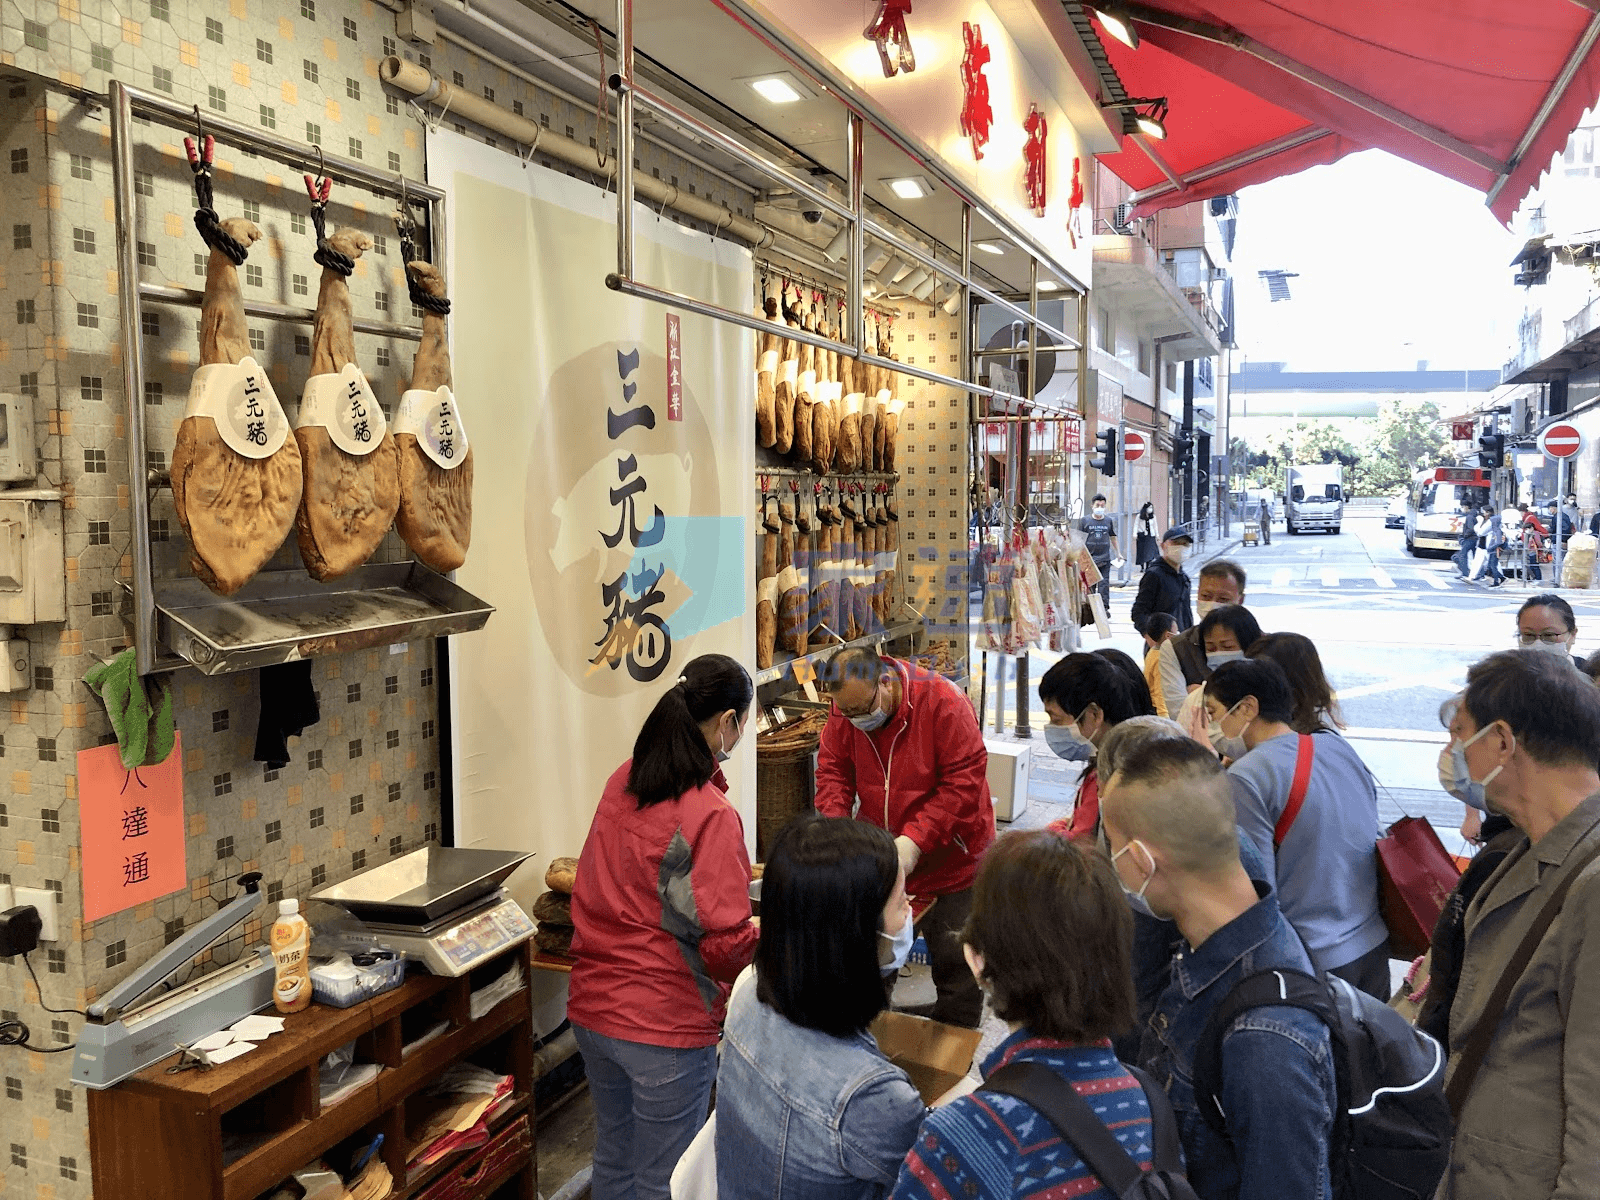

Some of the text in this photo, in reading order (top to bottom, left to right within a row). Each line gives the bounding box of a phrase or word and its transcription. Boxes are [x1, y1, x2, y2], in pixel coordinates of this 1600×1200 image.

[244, 376, 268, 446] 三元豬
[669, 320, 682, 418] 浙江金華
[348, 381, 371, 442] 三元豬
[438, 401, 454, 459] 三元豬
[588, 348, 672, 682] 三元豬
[120, 767, 151, 888] 八達通
